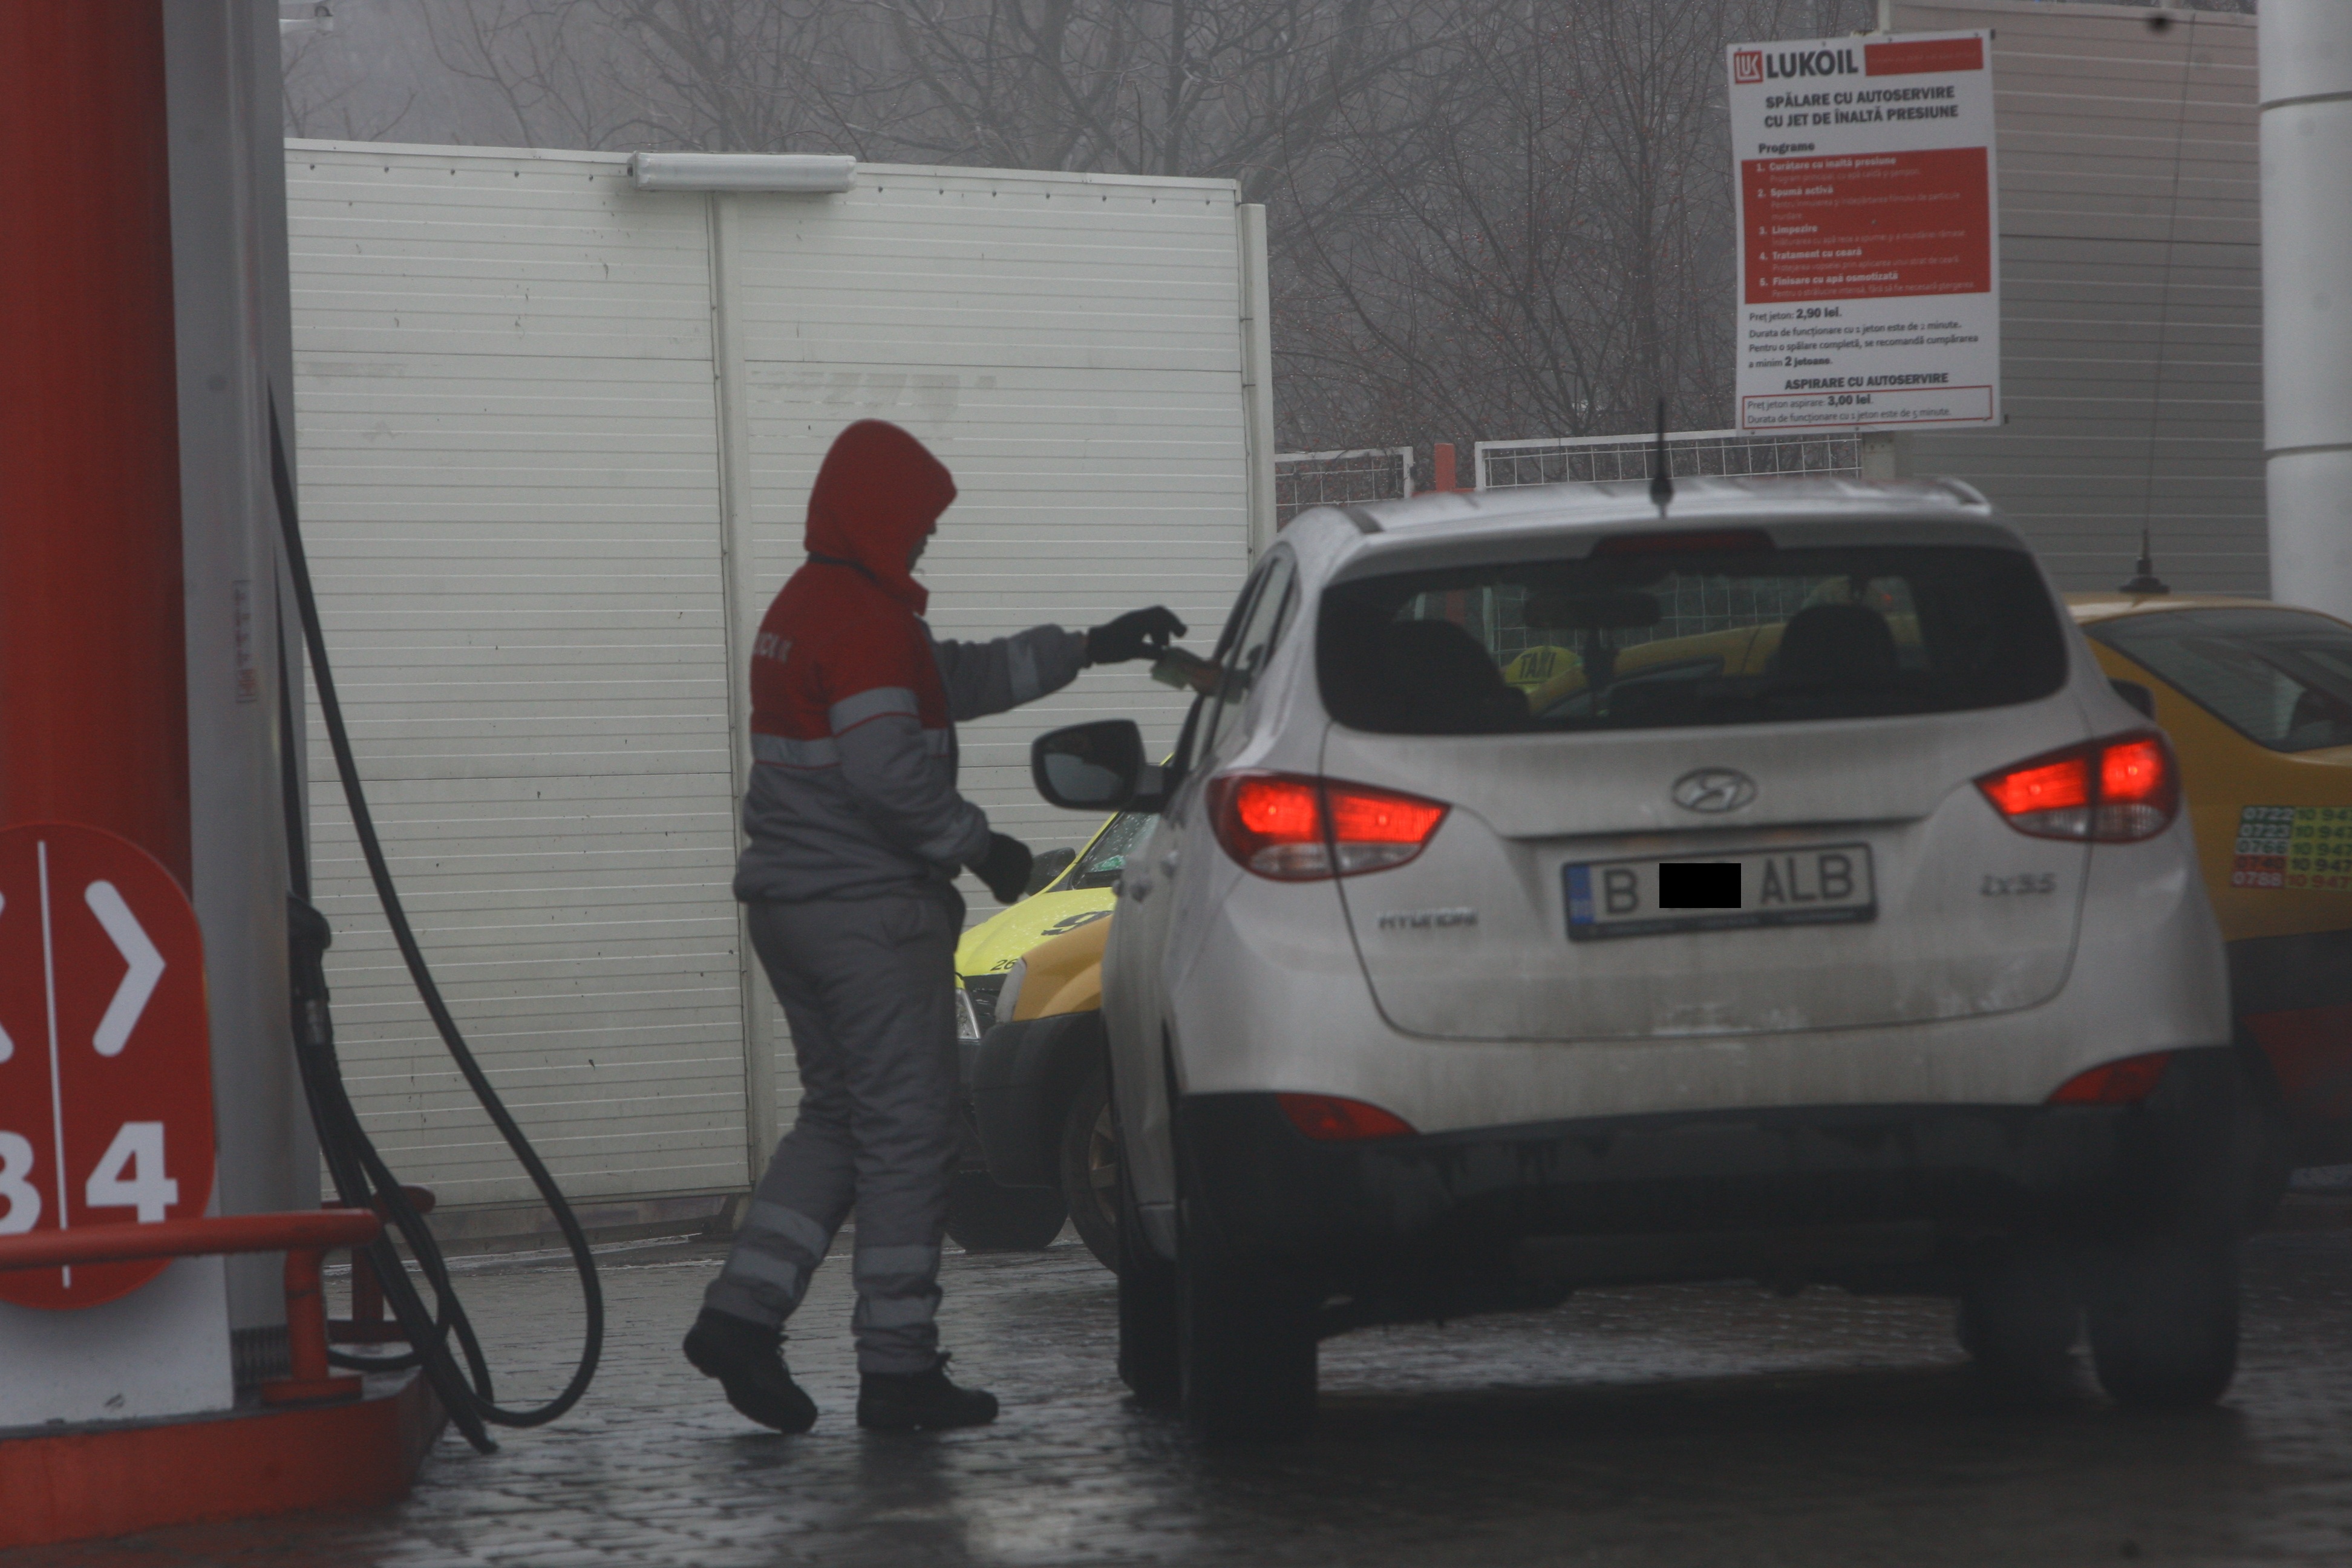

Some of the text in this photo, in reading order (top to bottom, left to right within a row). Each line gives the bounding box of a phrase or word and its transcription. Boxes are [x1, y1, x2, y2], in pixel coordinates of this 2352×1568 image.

[1766, 49, 1858, 78] LUKOIL
[1765, 86, 1954, 109] SPĂLARE CU AUTOSERVIRE
[1764, 114, 1783, 128] CU
[1786, 113, 1808, 127] JET
[1812, 111, 1831, 126] DE
[1886, 105, 1958, 122] PRESIUNE
[1758, 140, 1815, 156] Programe
[1854, 155, 1896, 169] presiune
[1771, 223, 1818, 237] Limpezire
[1772, 249, 1820, 260] Tratament
[1772, 275, 1811, 286] Finisare
[1795, 307, 1822, 320] 2,90
[1823, 305, 1843, 318] lei.
[1748, 328, 1779, 338] Durata
[1780, 327, 1791, 337] de
[1861, 323, 1886, 335] jeton
[1886, 322, 1906, 332] este
[1906, 322, 1919, 332] de
[1748, 342, 1777, 353] Pentru
[1875, 335, 1925, 347] recomandă
[1755, 358, 1783, 368] minim
[1783, 355, 1792, 367] 2
[1785, 372, 1948, 390] ASPIRARE CU AUTOSERVIRE
[1827, 394, 1854, 408] 3,00
[1747, 414, 1776, 424] Durata
[1777, 413, 1788, 423] de
[1855, 410, 1878, 422] jeton
[1880, 409, 1898, 419] este
[1899, 408, 1911, 418] de
[1519, 651, 1558, 679] TAXI
[1603, 868, 1639, 915] B
[1759, 852, 1854, 904] ALB
[85, 1120, 178, 1224] 4
